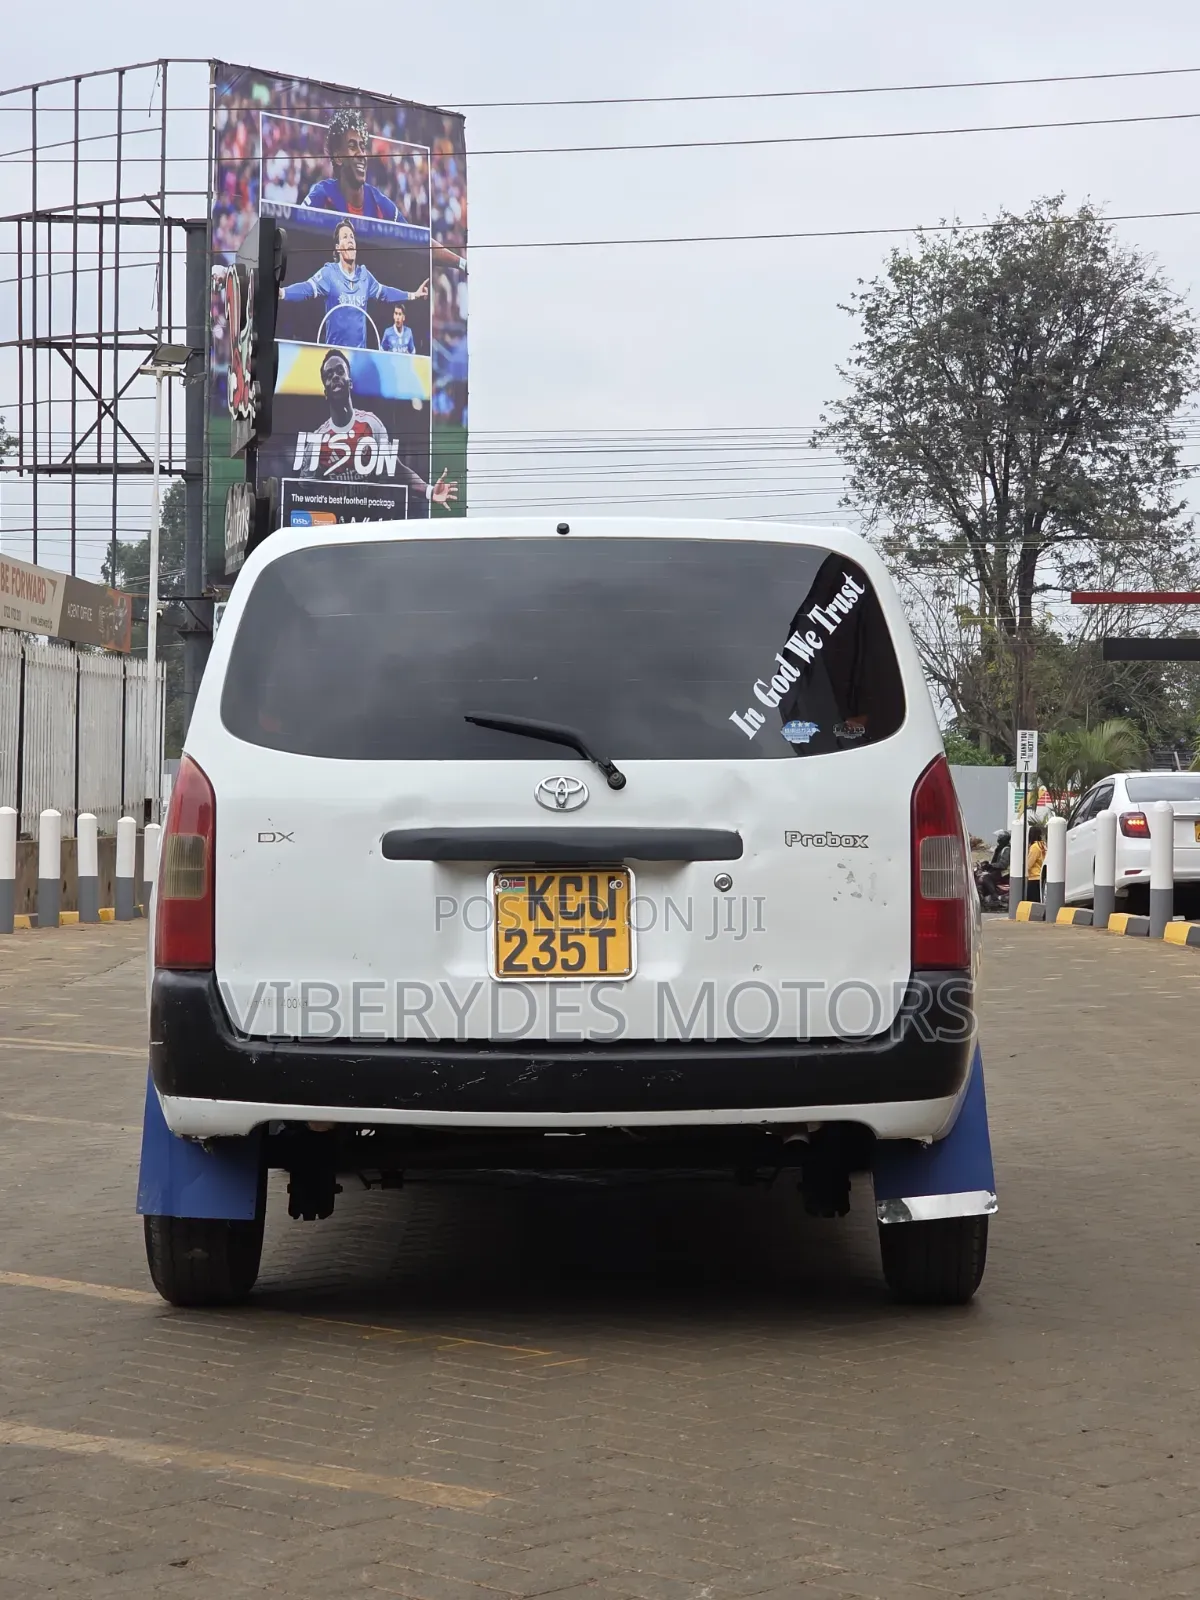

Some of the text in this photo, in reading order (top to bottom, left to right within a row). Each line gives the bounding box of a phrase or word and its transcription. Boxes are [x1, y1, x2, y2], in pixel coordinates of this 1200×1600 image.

[293, 431, 399, 477] IT'S ON
[291, 493, 395, 510] The world's best football package
[0, 563, 46, 604] BE FORWARD
[80, 607, 92, 621] OFFICE
[728, 707, 766, 741] In
[753, 653, 801, 708] God
[784, 630, 823, 664] We
[806, 571, 865, 635] Trust
[257, 831, 296, 843] DX
[784, 830, 869, 849] Probox
[527, 875, 617, 922] KCU
[503, 928, 617, 972] 235T
